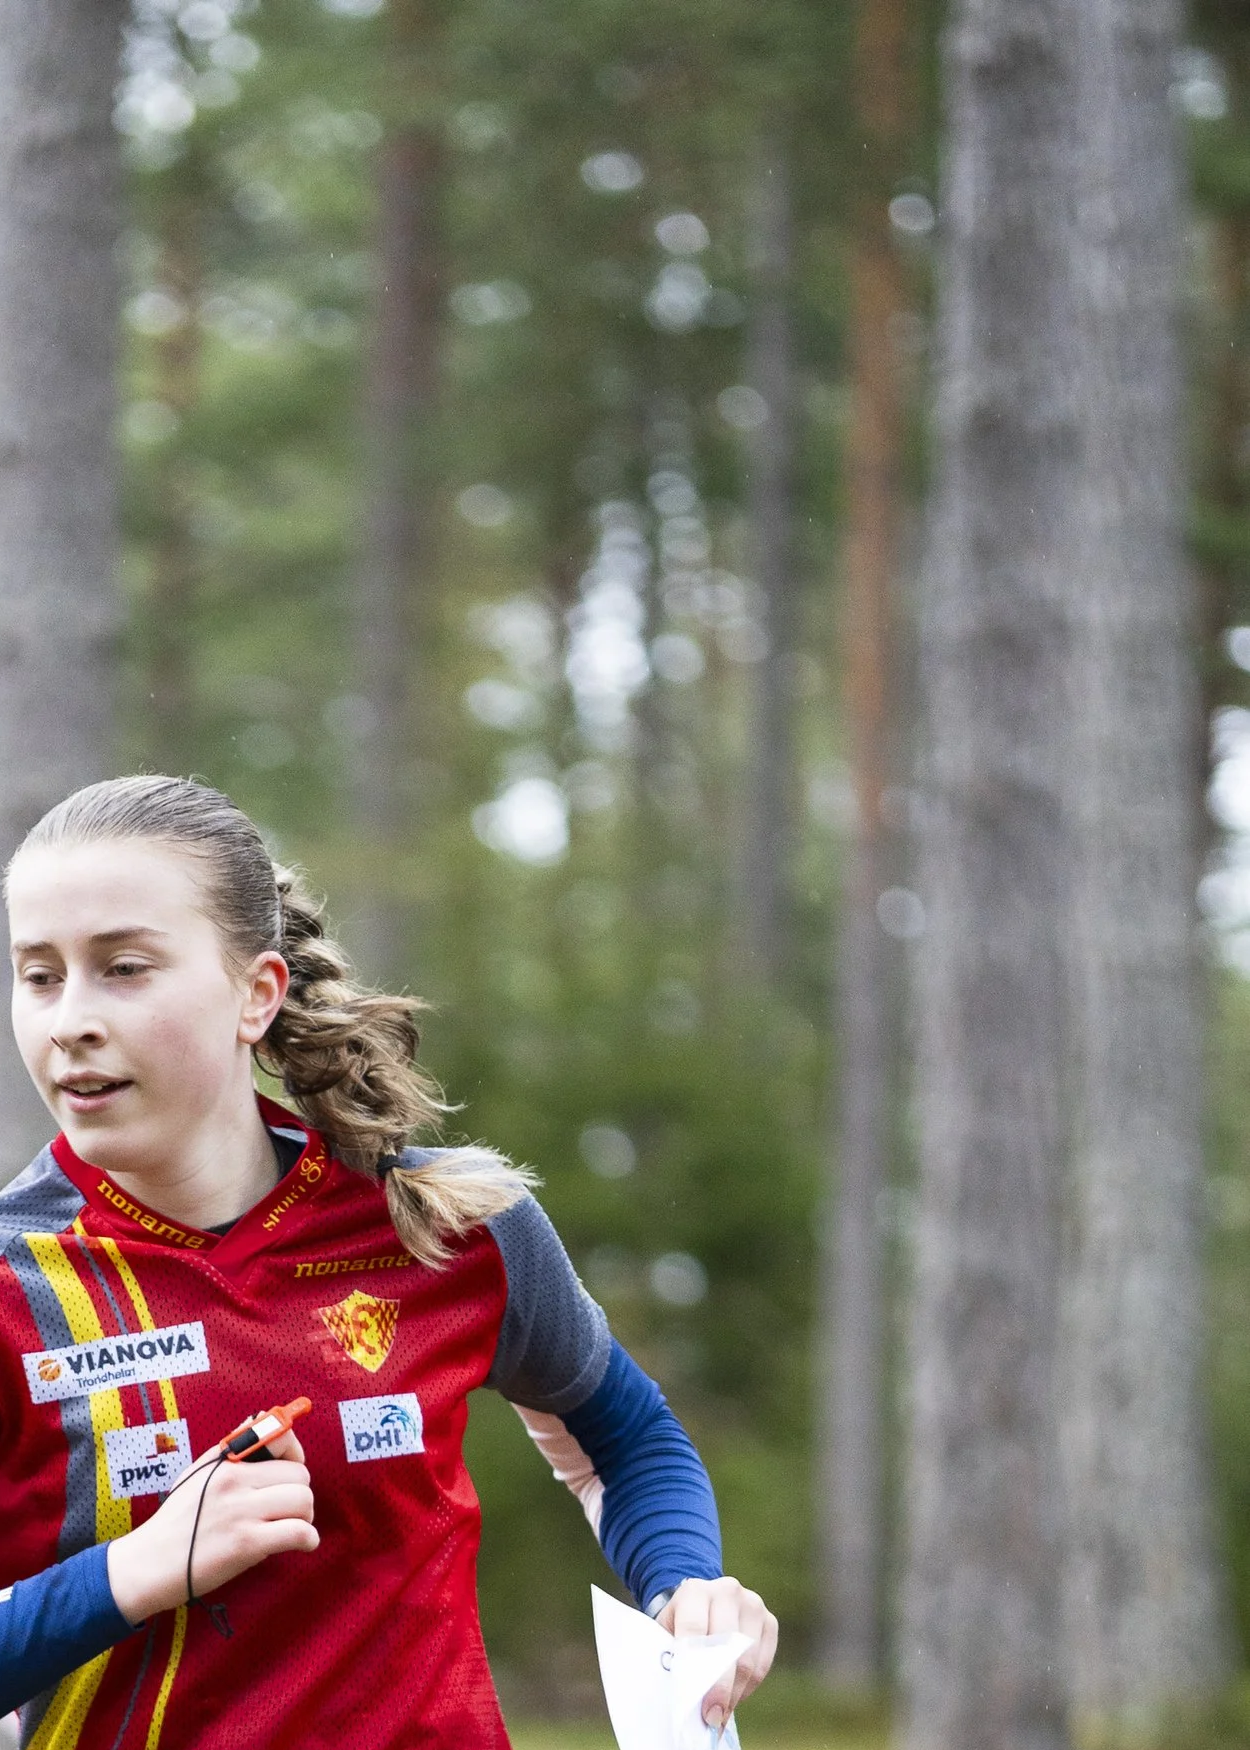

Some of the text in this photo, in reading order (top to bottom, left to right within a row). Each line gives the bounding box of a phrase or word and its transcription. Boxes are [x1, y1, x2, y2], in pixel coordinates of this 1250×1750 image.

[97, 1180, 205, 1249] noname
[66, 1334, 195, 1374] VIANOVA
[117, 1462, 167, 1488] pwc
